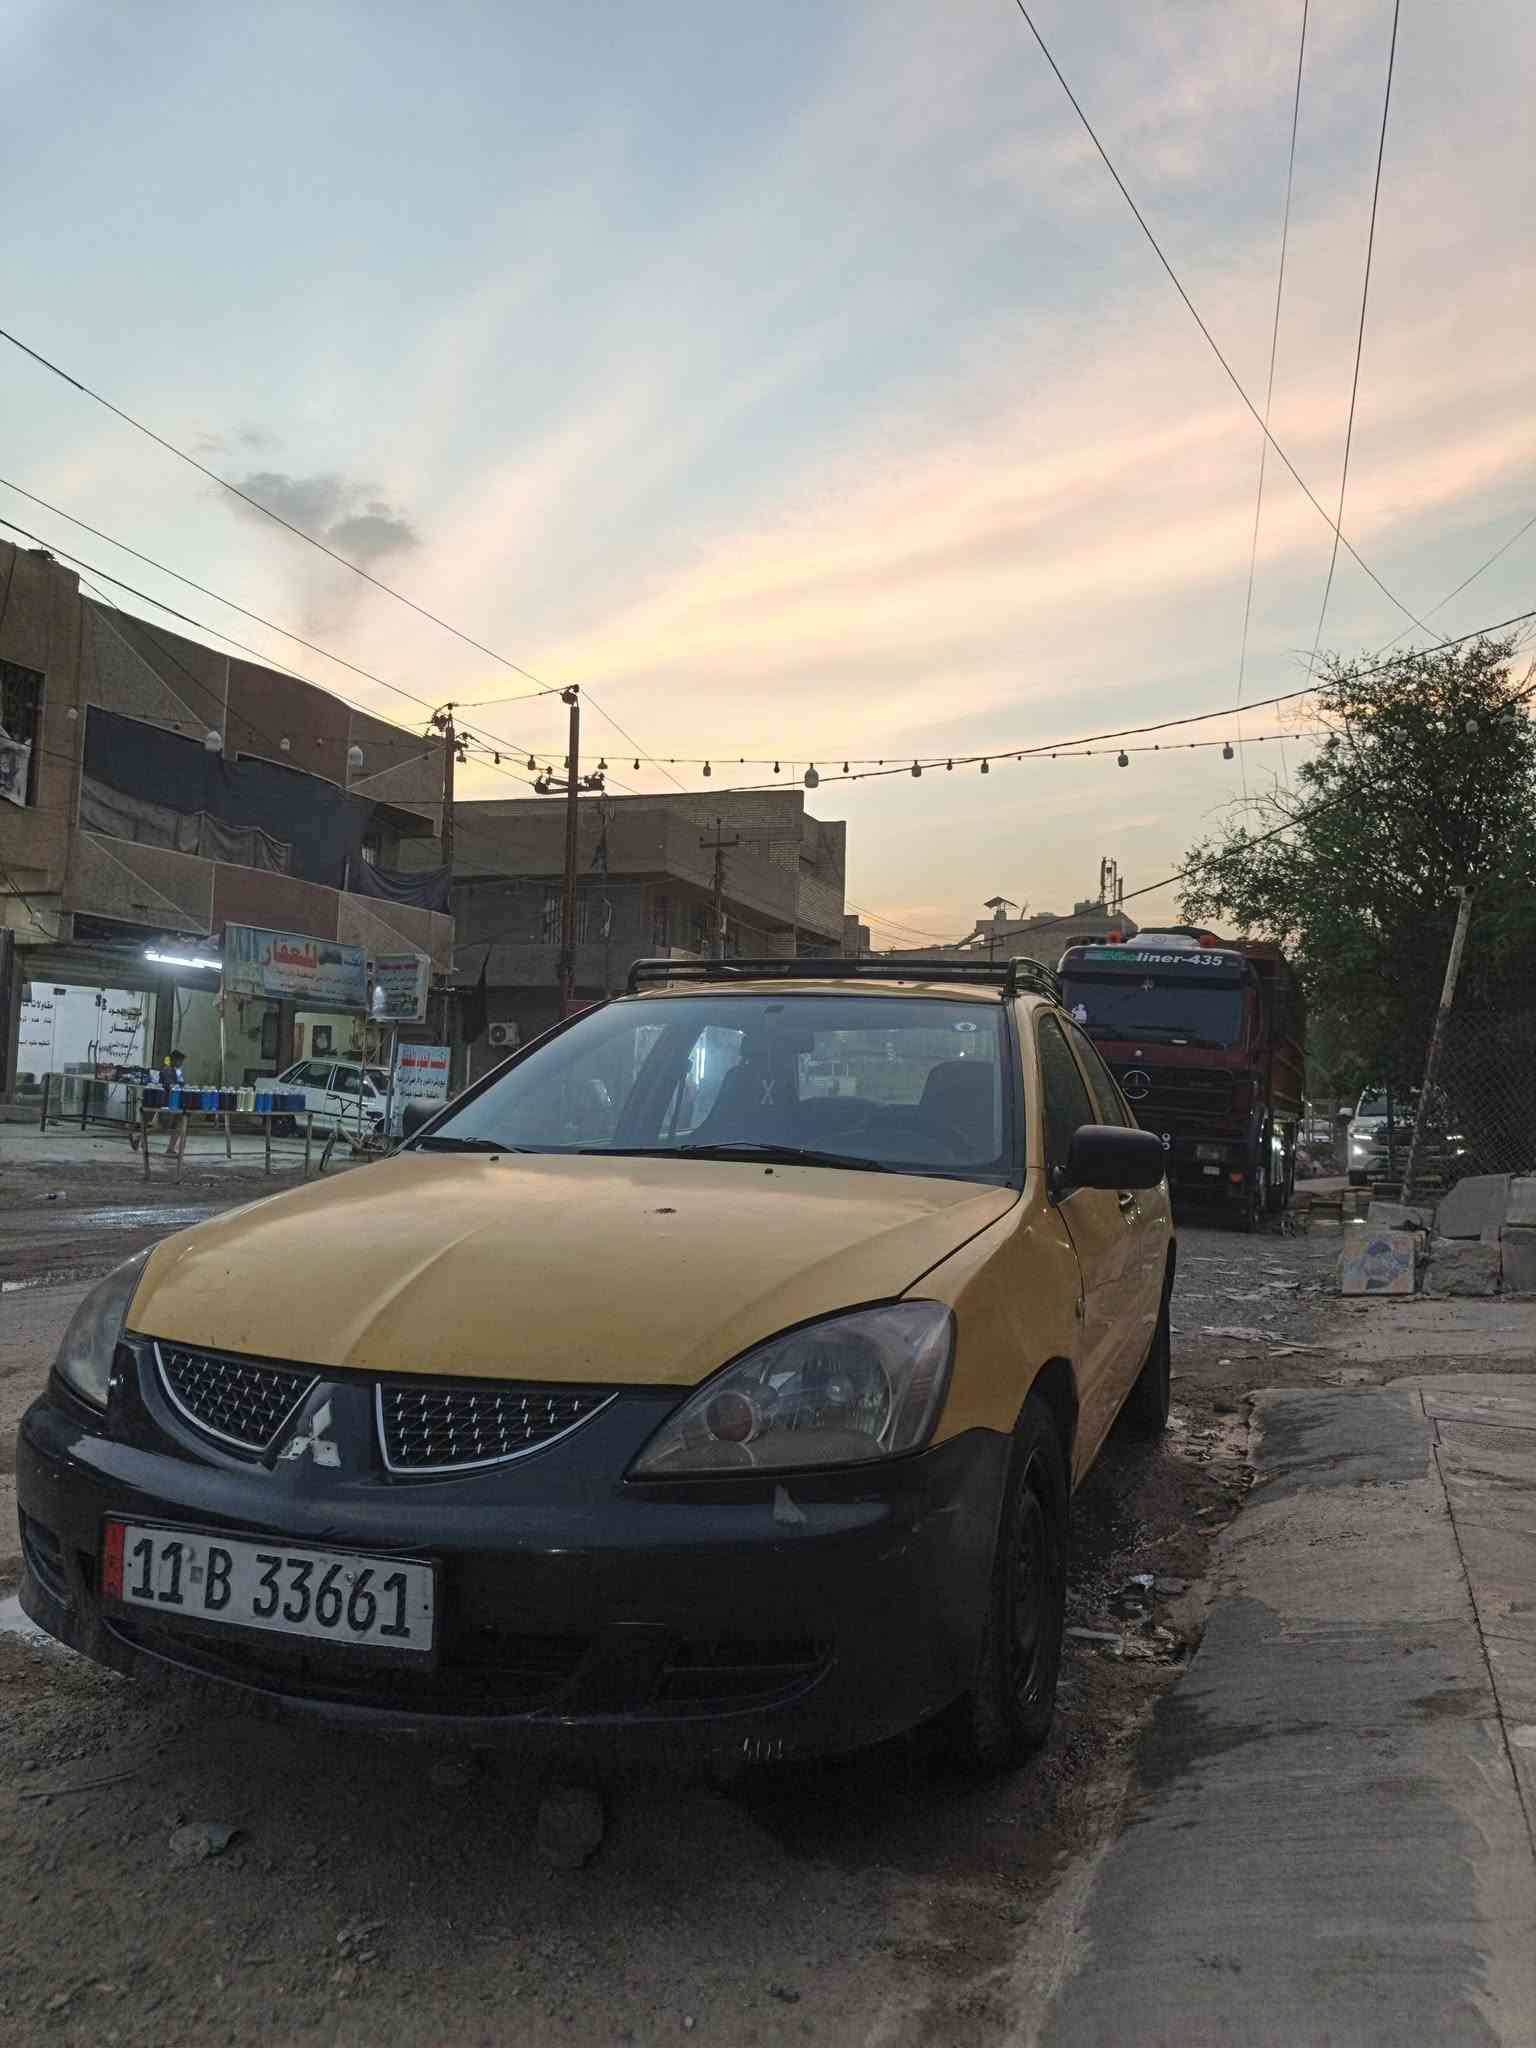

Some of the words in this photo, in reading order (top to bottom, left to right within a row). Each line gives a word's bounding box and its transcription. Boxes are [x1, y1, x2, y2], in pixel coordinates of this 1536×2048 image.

[131, 1537, 184, 1604] 11
[204, 1546, 233, 1610] B
[252, 1553, 411, 1639] 33661
